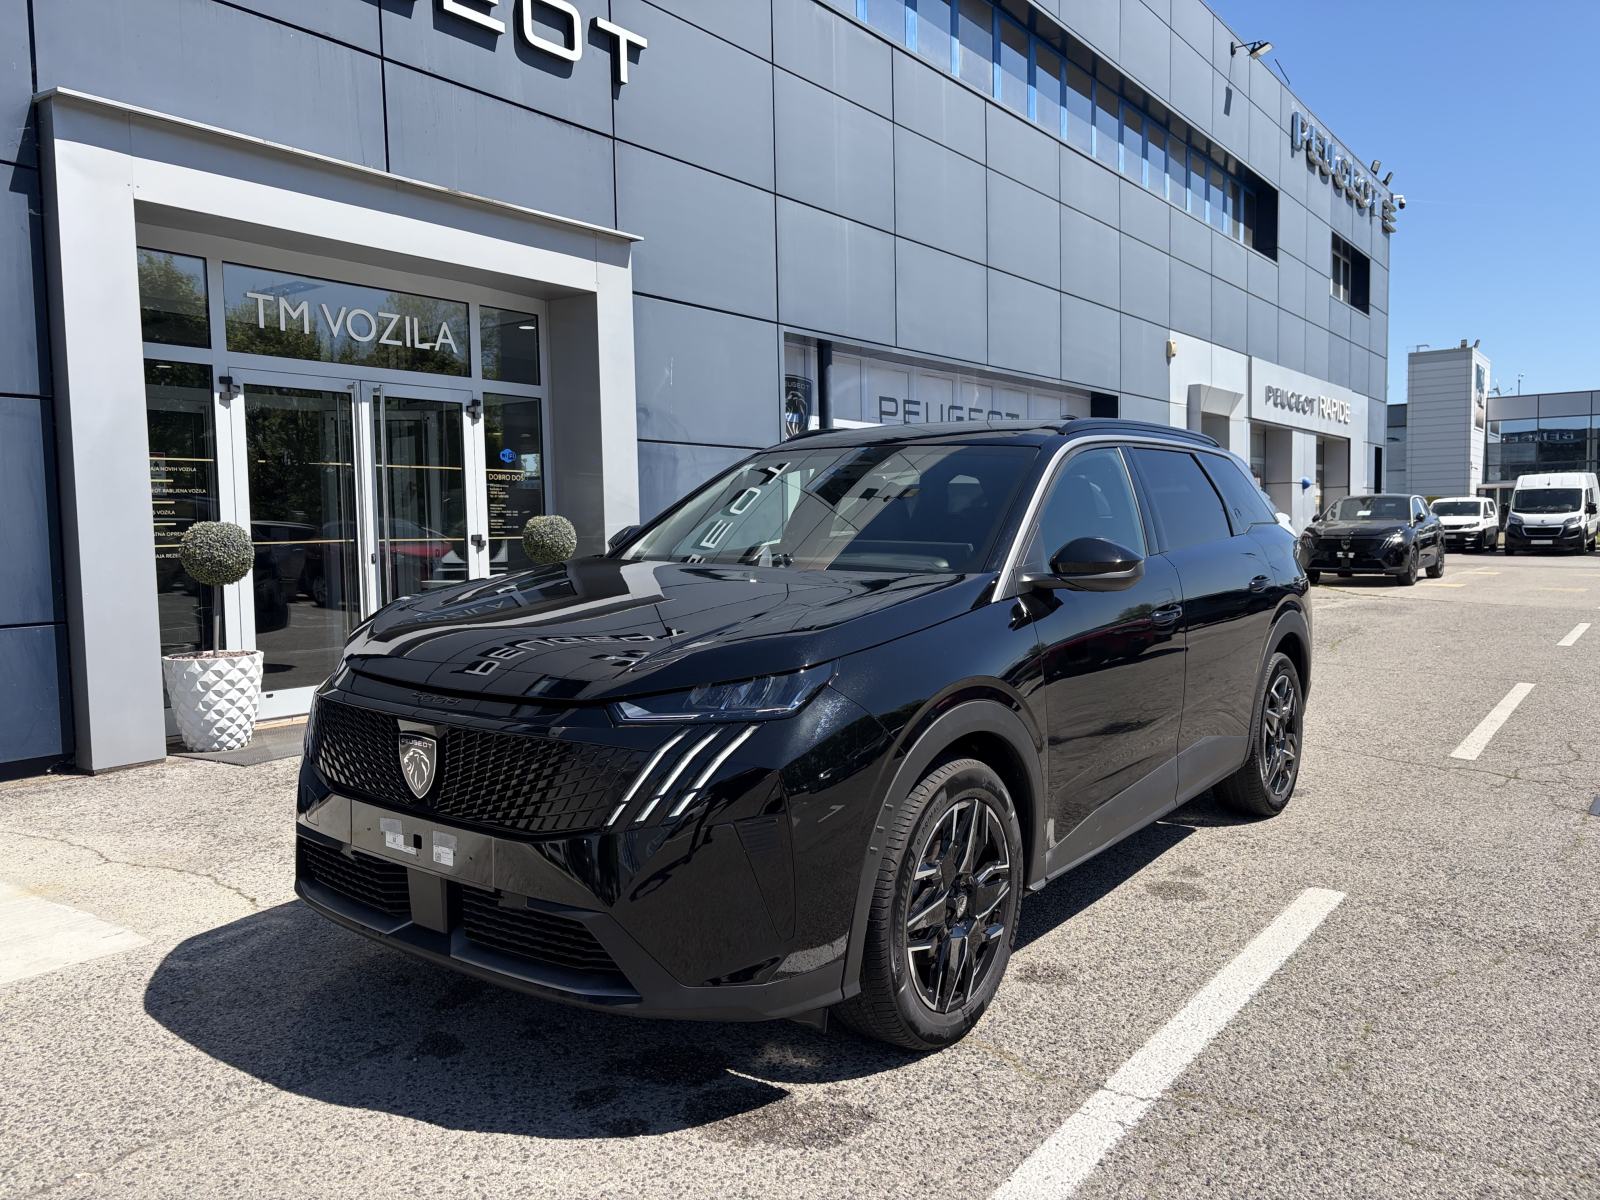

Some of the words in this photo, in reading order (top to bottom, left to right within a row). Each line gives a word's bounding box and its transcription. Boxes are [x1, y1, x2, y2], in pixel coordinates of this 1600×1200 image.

[1292, 111, 1382, 217] PEUGEOT
[246, 291, 310, 335] TM
[320, 303, 458, 354] VOZILA
[785, 381, 810, 391] UGEOT
[1264, 385, 1316, 417] PEUGEOT
[1317, 396, 1351, 425] RAPIDE
[488, 473, 511, 481] DOBRO
